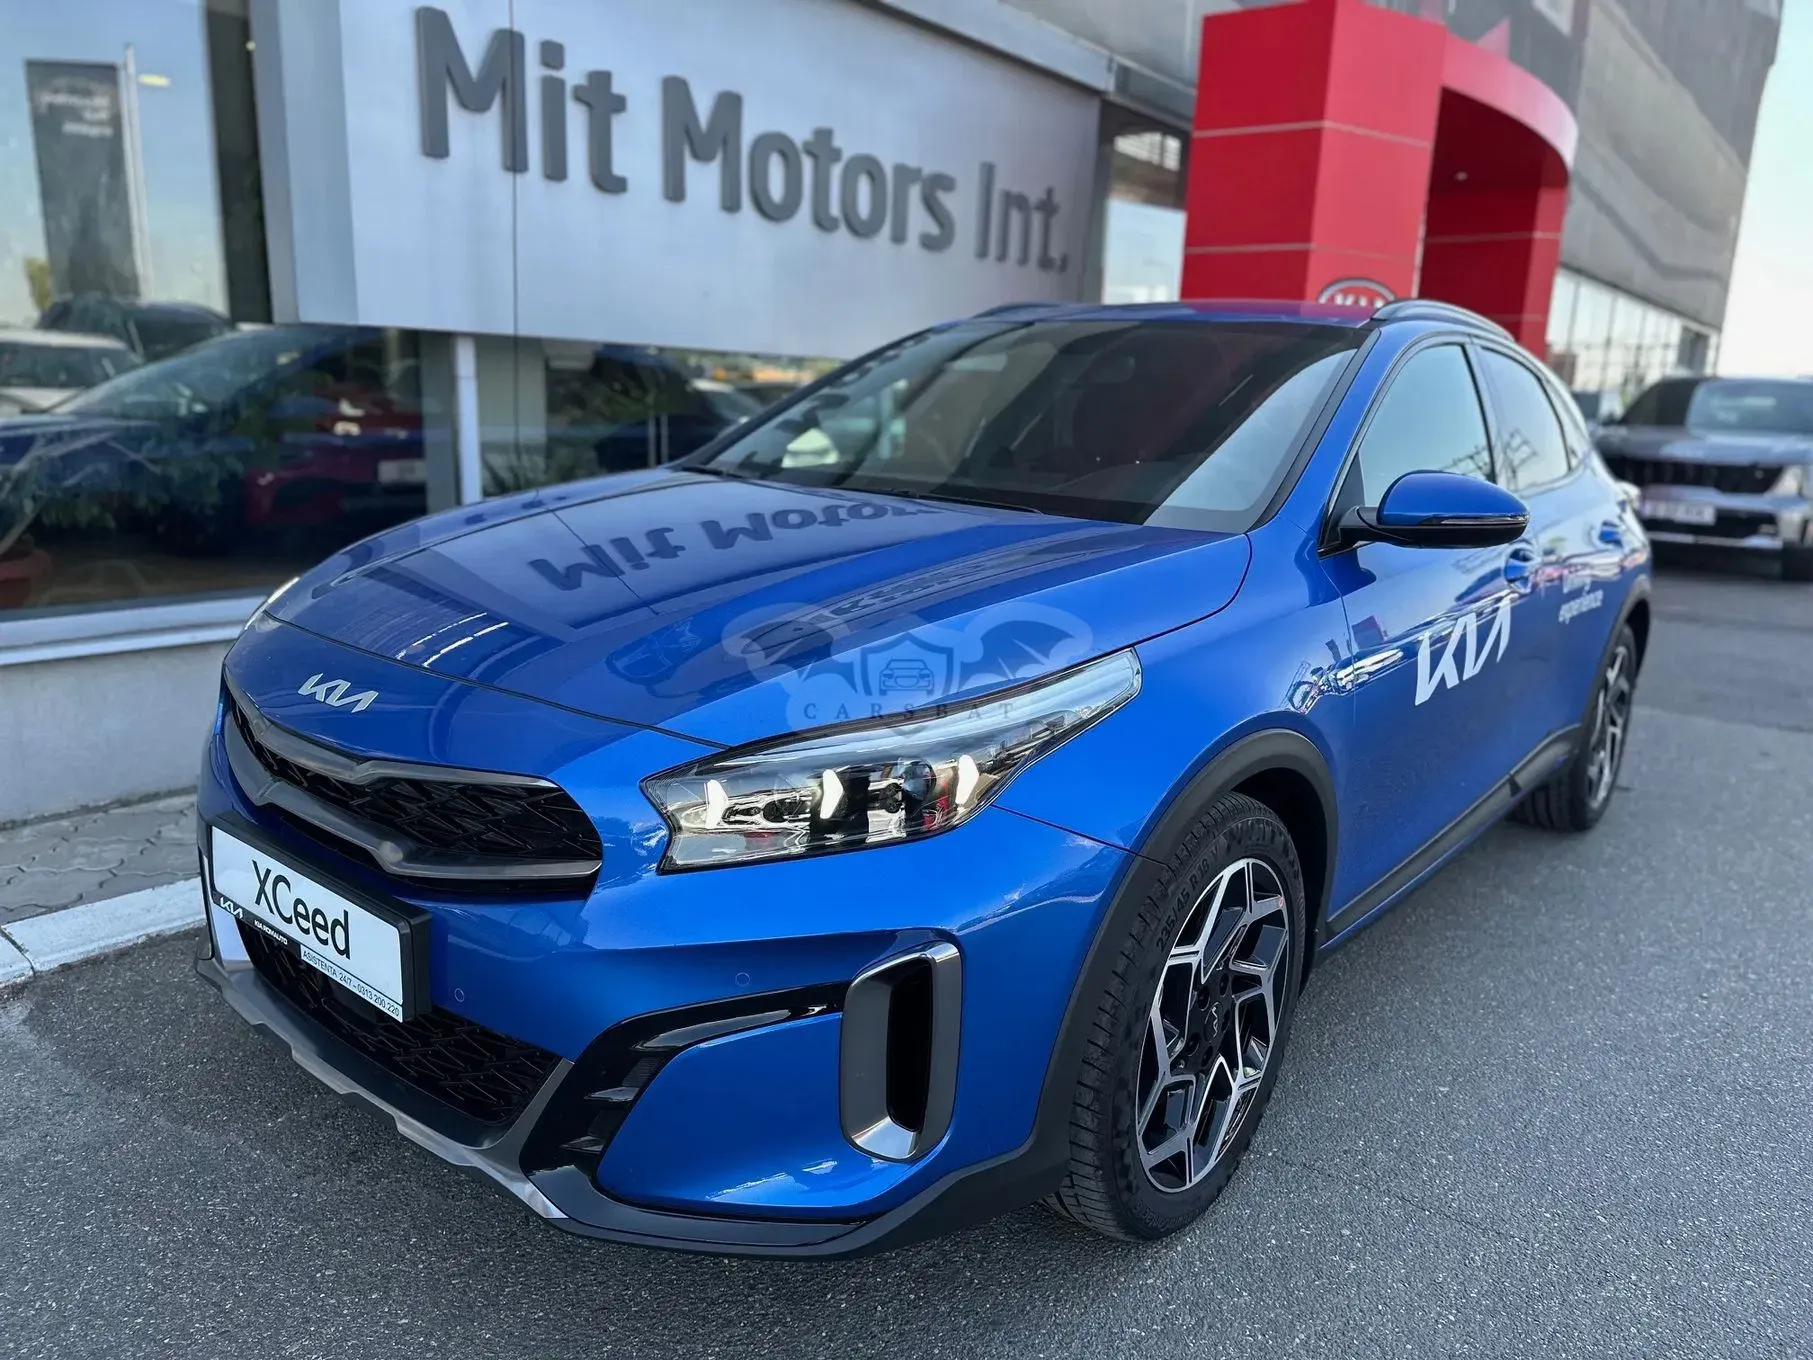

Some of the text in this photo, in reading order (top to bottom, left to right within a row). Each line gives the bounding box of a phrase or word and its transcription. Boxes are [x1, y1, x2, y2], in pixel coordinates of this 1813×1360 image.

[415, 5, 1069, 274] Mit Motors Int.
[297, 673, 379, 713] KIA
[251, 859, 351, 960] XCeed
[303, 950, 337, 978] ASISTENTA
